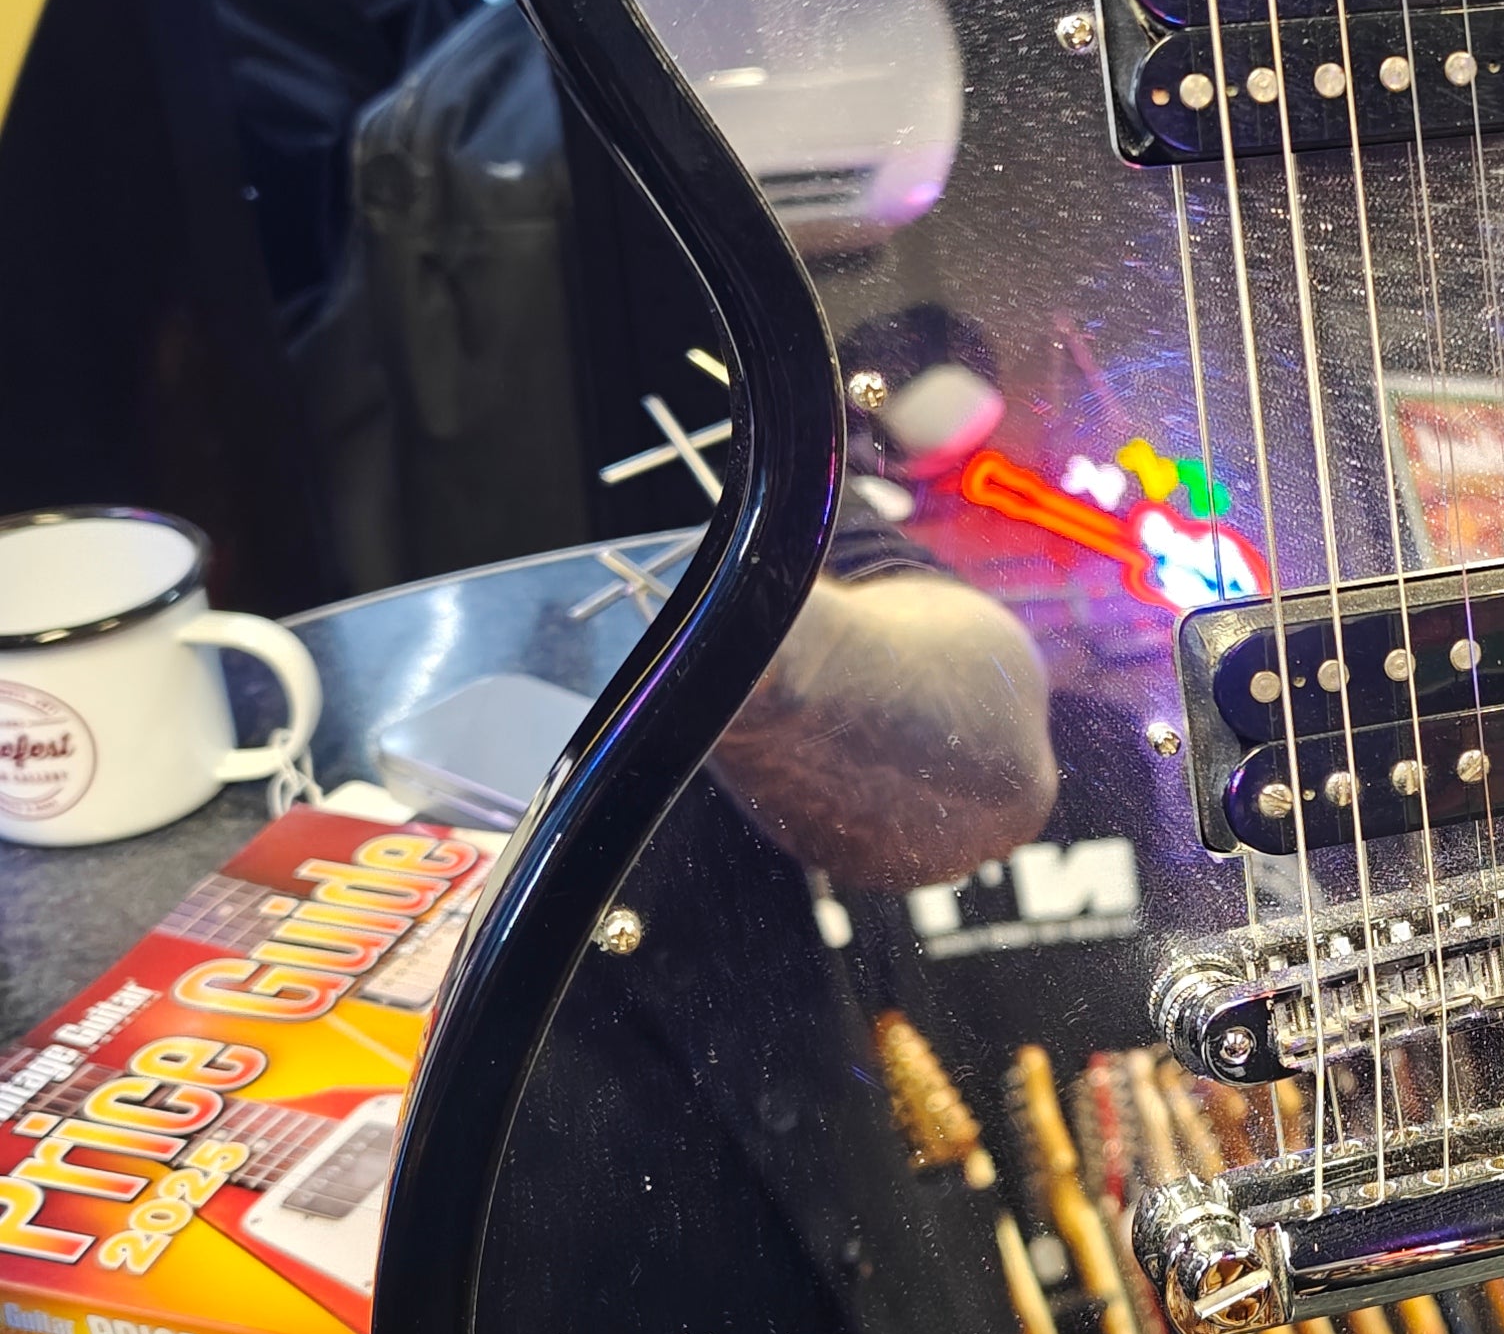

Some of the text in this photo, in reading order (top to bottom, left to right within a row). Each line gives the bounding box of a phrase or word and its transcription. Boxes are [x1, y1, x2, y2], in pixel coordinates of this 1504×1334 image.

[0, 833, 479, 1265] Price Guide
[53, 978, 160, 1049] Guitar
[98, 1139, 250, 1275] 2025
